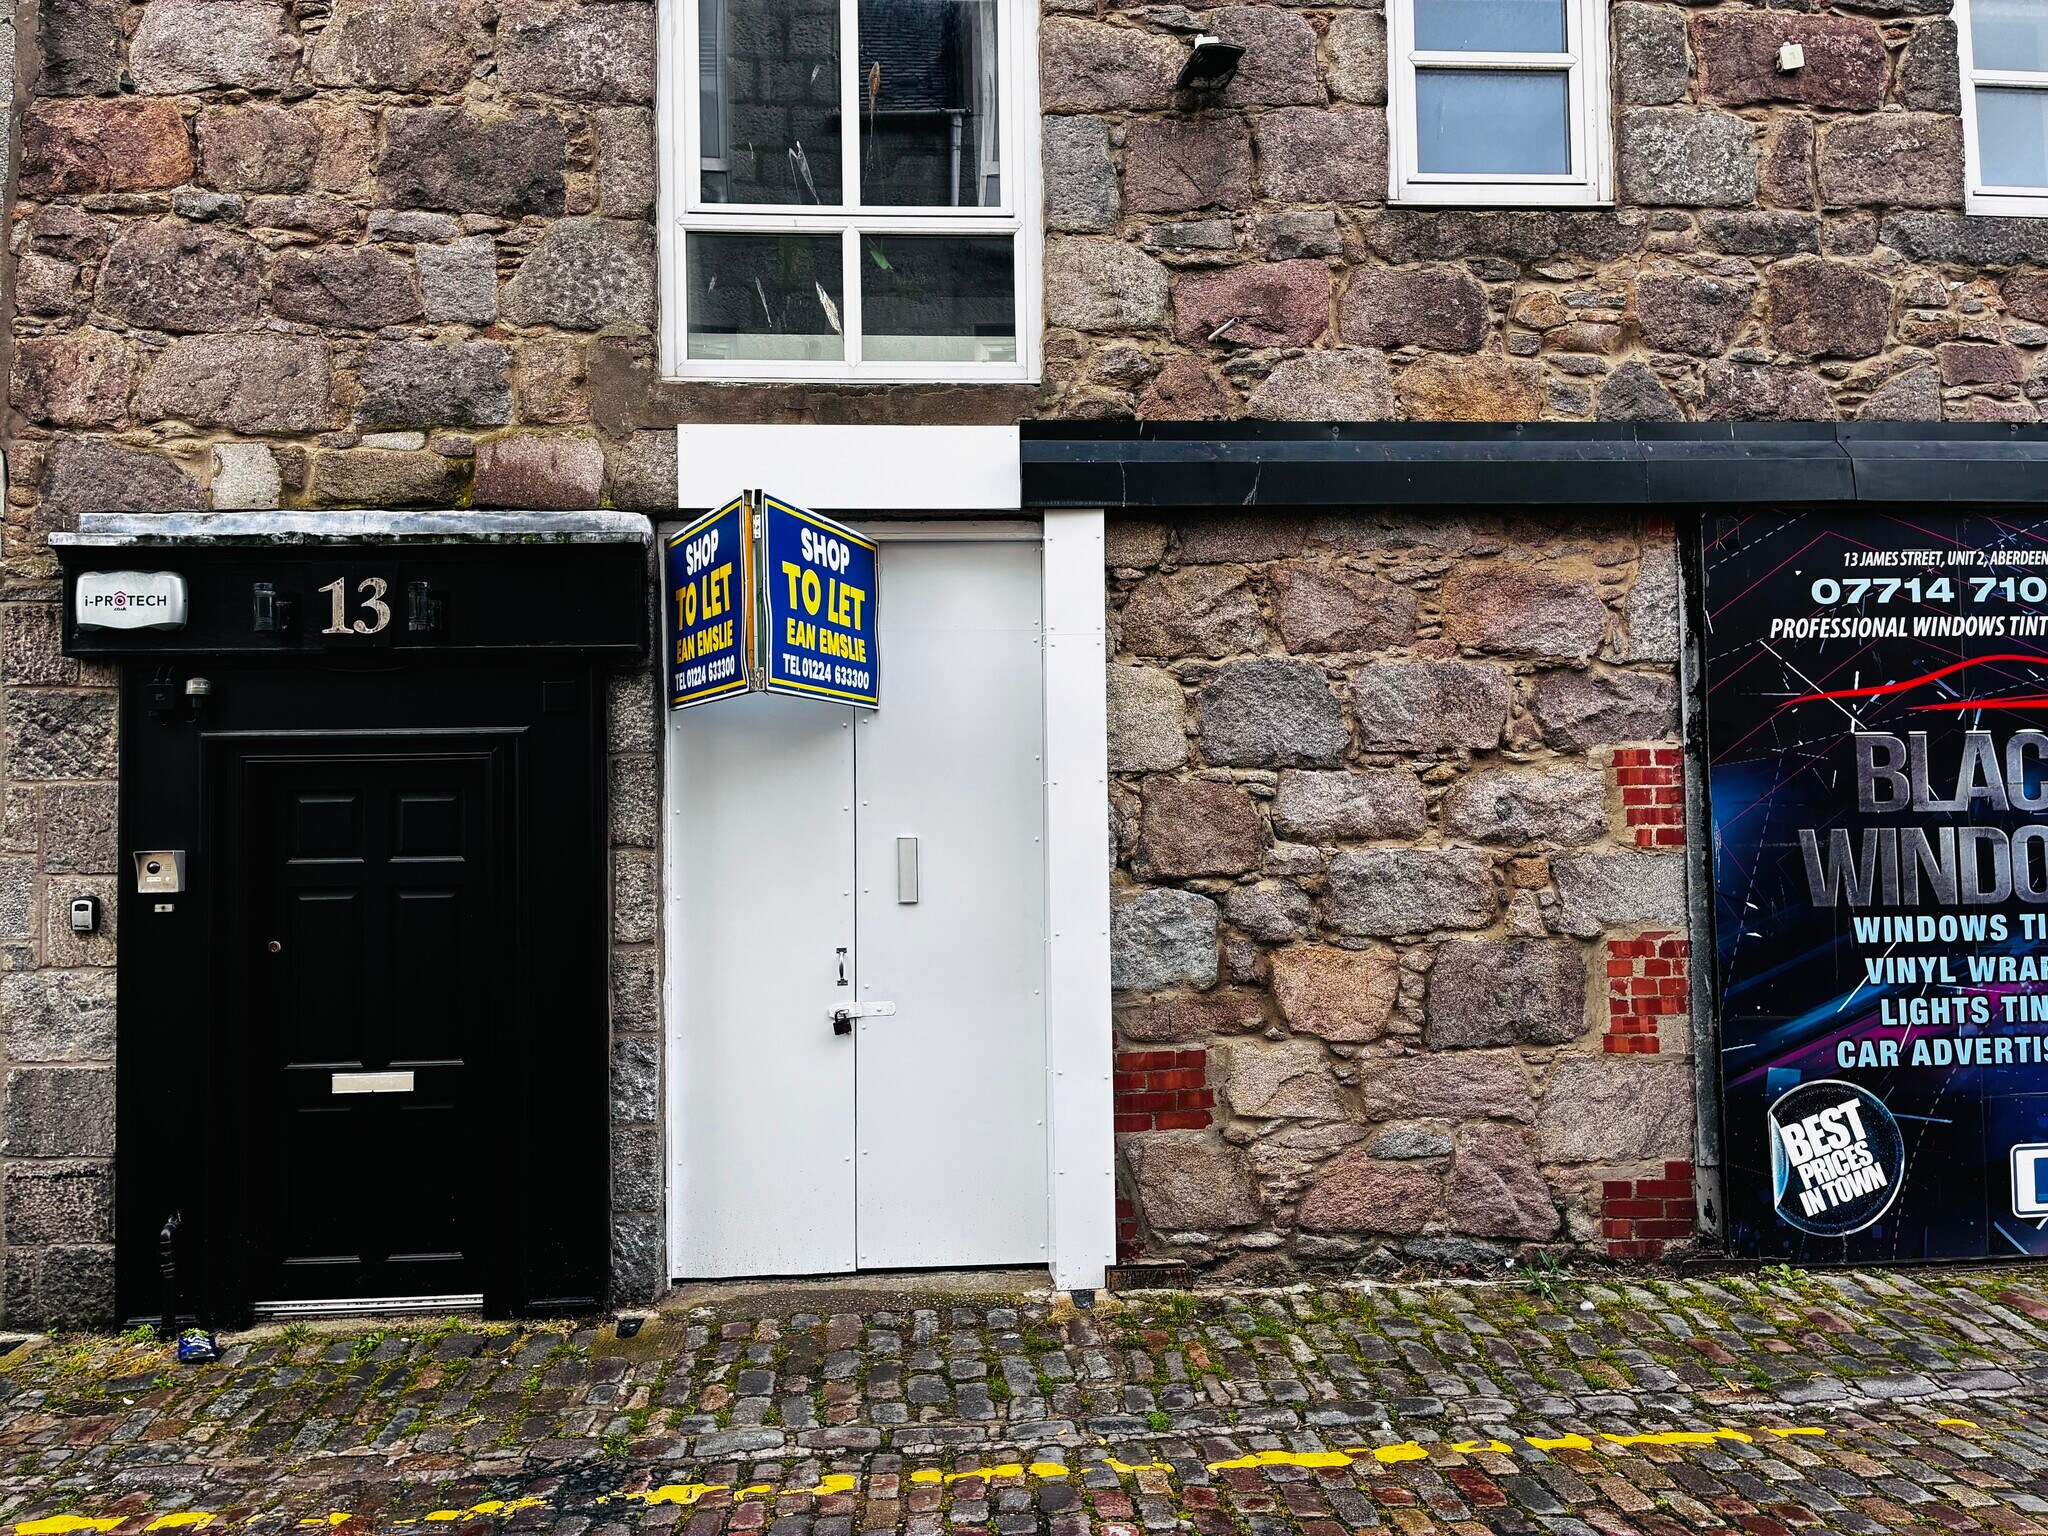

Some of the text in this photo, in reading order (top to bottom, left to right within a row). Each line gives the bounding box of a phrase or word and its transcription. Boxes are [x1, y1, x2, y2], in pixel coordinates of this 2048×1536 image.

[685, 528, 719, 576] SHOP
[800, 527, 850, 574] SHOP
[1844, 550, 2048, 568] 13 JAMES STREET, UNIT 2, ABERDEEN
[85, 591, 167, 606] i-PROTECH
[318, 577, 391, 634] 13
[675, 562, 732, 631] TO LET
[782, 560, 866, 631] TO LET
[1811, 577, 2047, 604] 07714 710
[676, 619, 733, 665] EAN EMSLIE
[786, 617, 867, 663] EAN EMSLIE
[1770, 615, 2048, 639] PROFESSIONAL WINDOWS TINT
[675, 654, 735, 692] TEL 01224 633300
[782, 653, 869, 690] TEL 01224 633300
[1854, 729, 2048, 813] BLAC
[1798, 825, 2048, 906] WINDO
[1853, 914, 2008, 943] WINDOWS
[1865, 957, 1956, 985] VINYL
[1881, 996, 1990, 1026] LIGHTS
[1837, 1036, 2048, 1068] CAR ADVERTI
[1780, 1097, 1867, 1167] BEST
[1797, 1140, 1874, 1190] PRICES
[1799, 1161, 1888, 1218] IN TOWN
